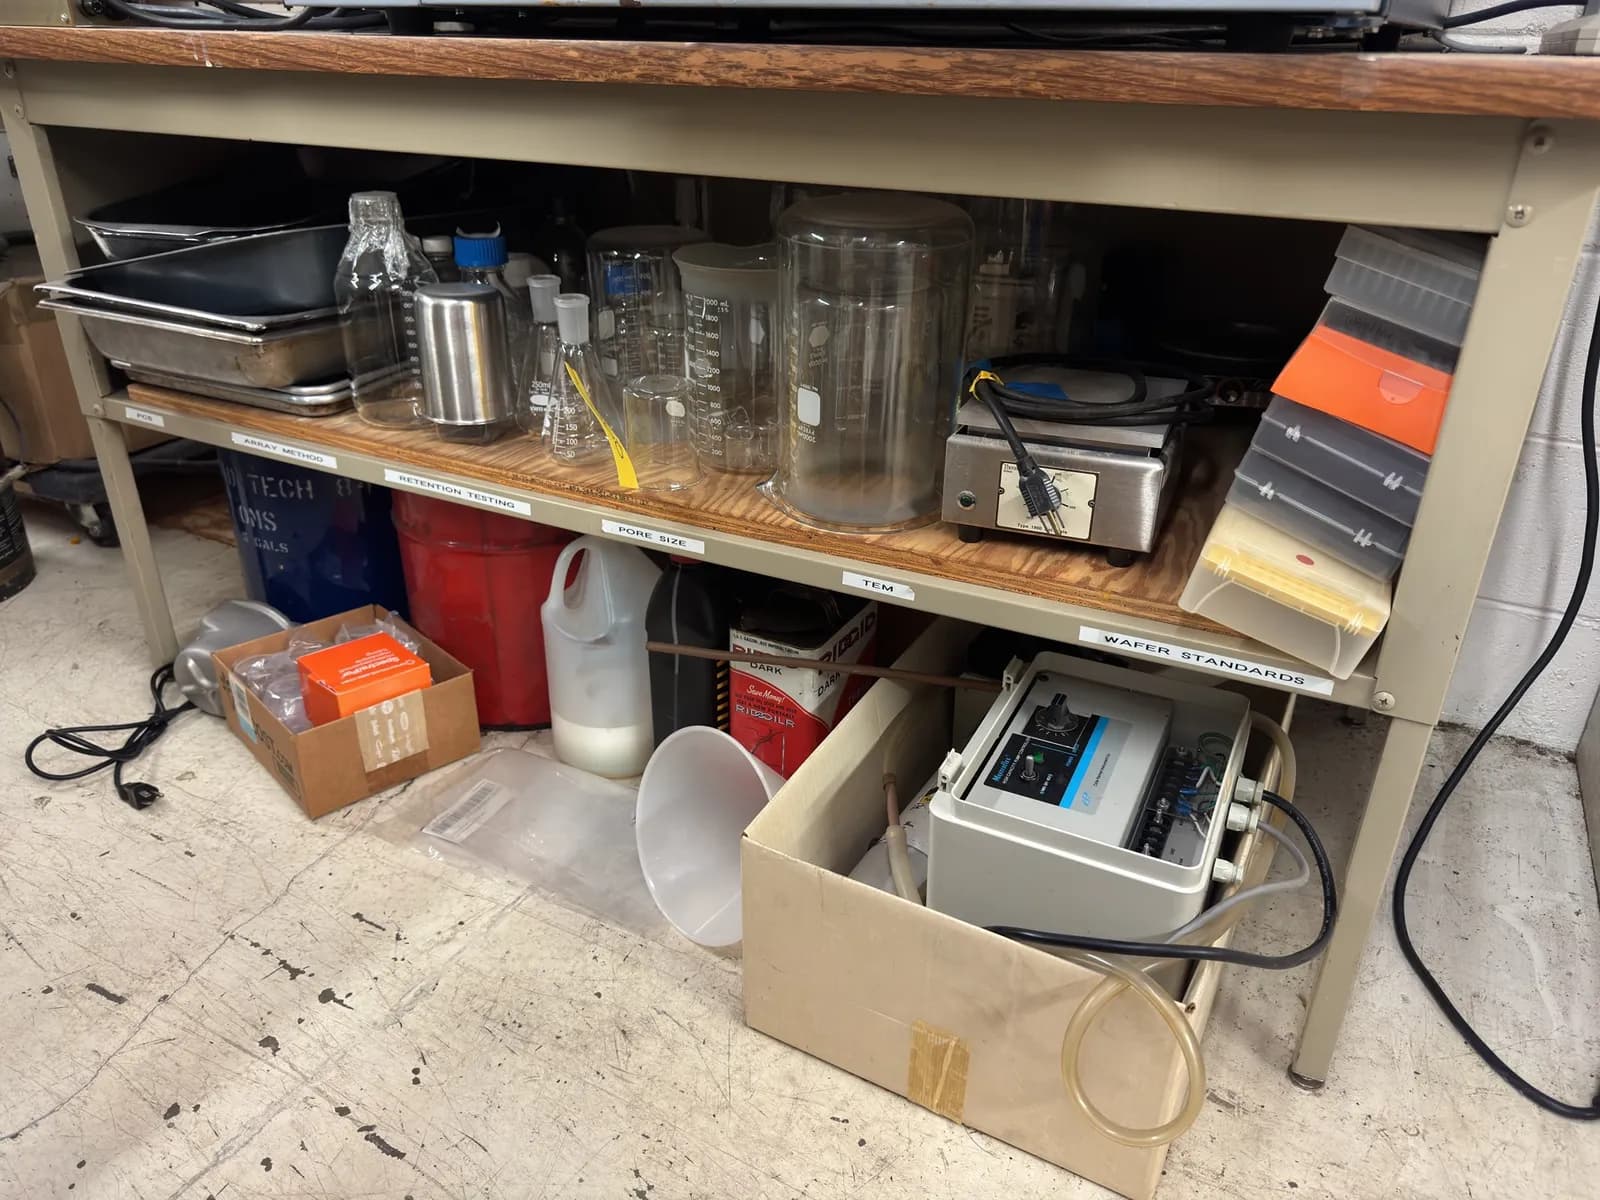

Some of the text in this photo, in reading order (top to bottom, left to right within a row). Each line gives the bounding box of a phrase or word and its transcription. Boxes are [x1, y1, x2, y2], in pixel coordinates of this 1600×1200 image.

[565, 423, 577, 431] 150
[244, 438, 324, 463] ARRAY METHOD
[566, 450, 576, 458] 50
[247, 473, 314, 500] TECH
[399, 475, 516, 509] RETENTION TESTING
[618, 526, 687, 547] PORE SIZE
[862, 579, 894, 592] TEM
[750, 661, 782, 675] DARK
[1104, 635, 1306, 686] WAFER STANDARDS
